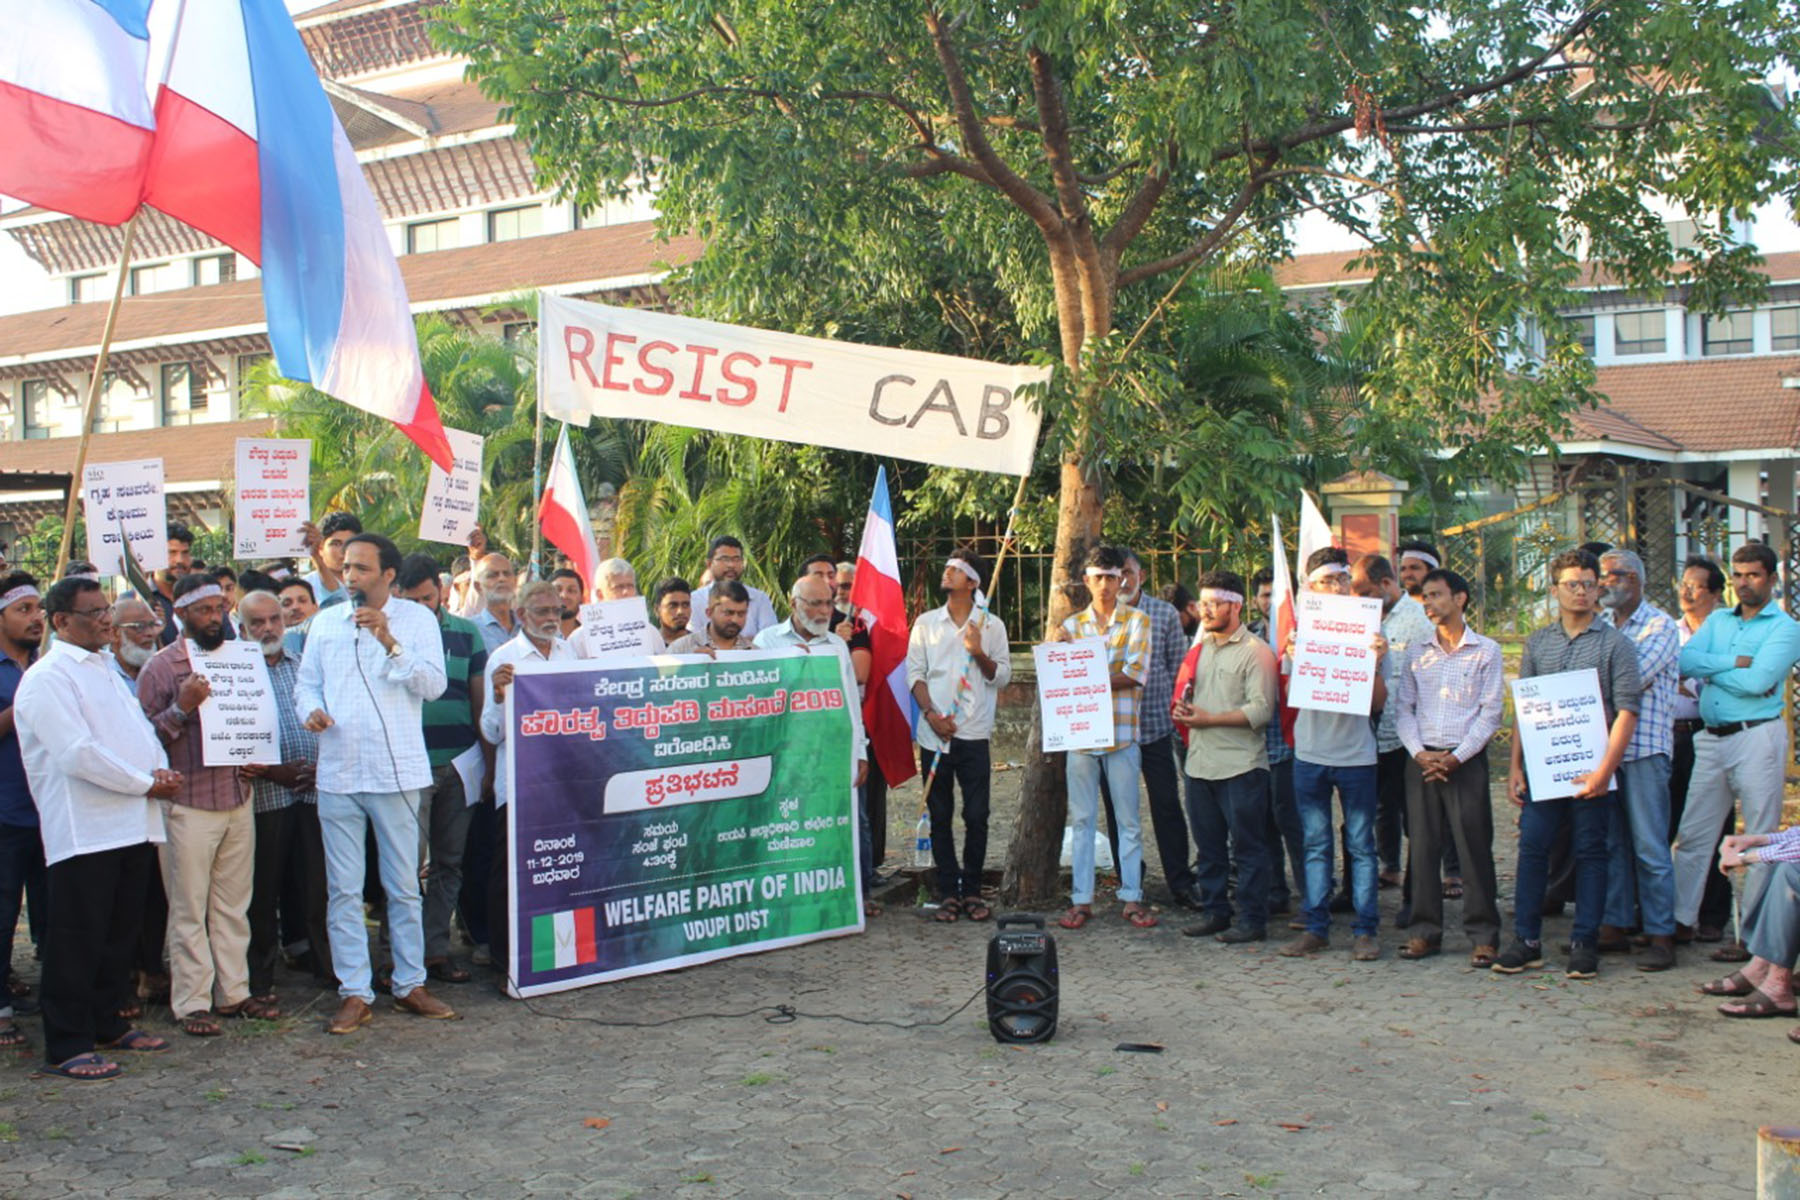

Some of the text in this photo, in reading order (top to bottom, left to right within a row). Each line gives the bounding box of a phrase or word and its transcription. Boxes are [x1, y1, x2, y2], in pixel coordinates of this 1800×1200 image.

[564, 325, 1012, 440] RESIST CAB
[91, 487, 110, 505] ಗೃಹ
[1312, 619, 1366, 634] ಸಂವಿಧಾನದ
[594, 667, 780, 699] ಕೇಂದ್ರ ಸರಕಾರ ಮಂಡಿಸಿದ
[521, 688, 844, 740] ಪೌರತ್ವ ತಿದ್ದುಪಡಿ ಮಸೂದೆ 2019
[654, 736, 731, 758] ವಿರೋಧಿಸಿ
[645, 763, 739, 806] ಪ್ರತಿಭಟನೆ
[643, 821, 678, 838] ಸಮಯ
[534, 834, 576, 853] ದಿನಾಂಕ
[768, 836, 815, 852] ಮಣಿಪಾಲ
[527, 851, 584, 870] 11-12-2019
[532, 866, 580, 885] ಬುಧವಾರ
[604, 865, 846, 928] WELFARE PARTY OF INDIA
[683, 908, 770, 941] UDUPI DIST
